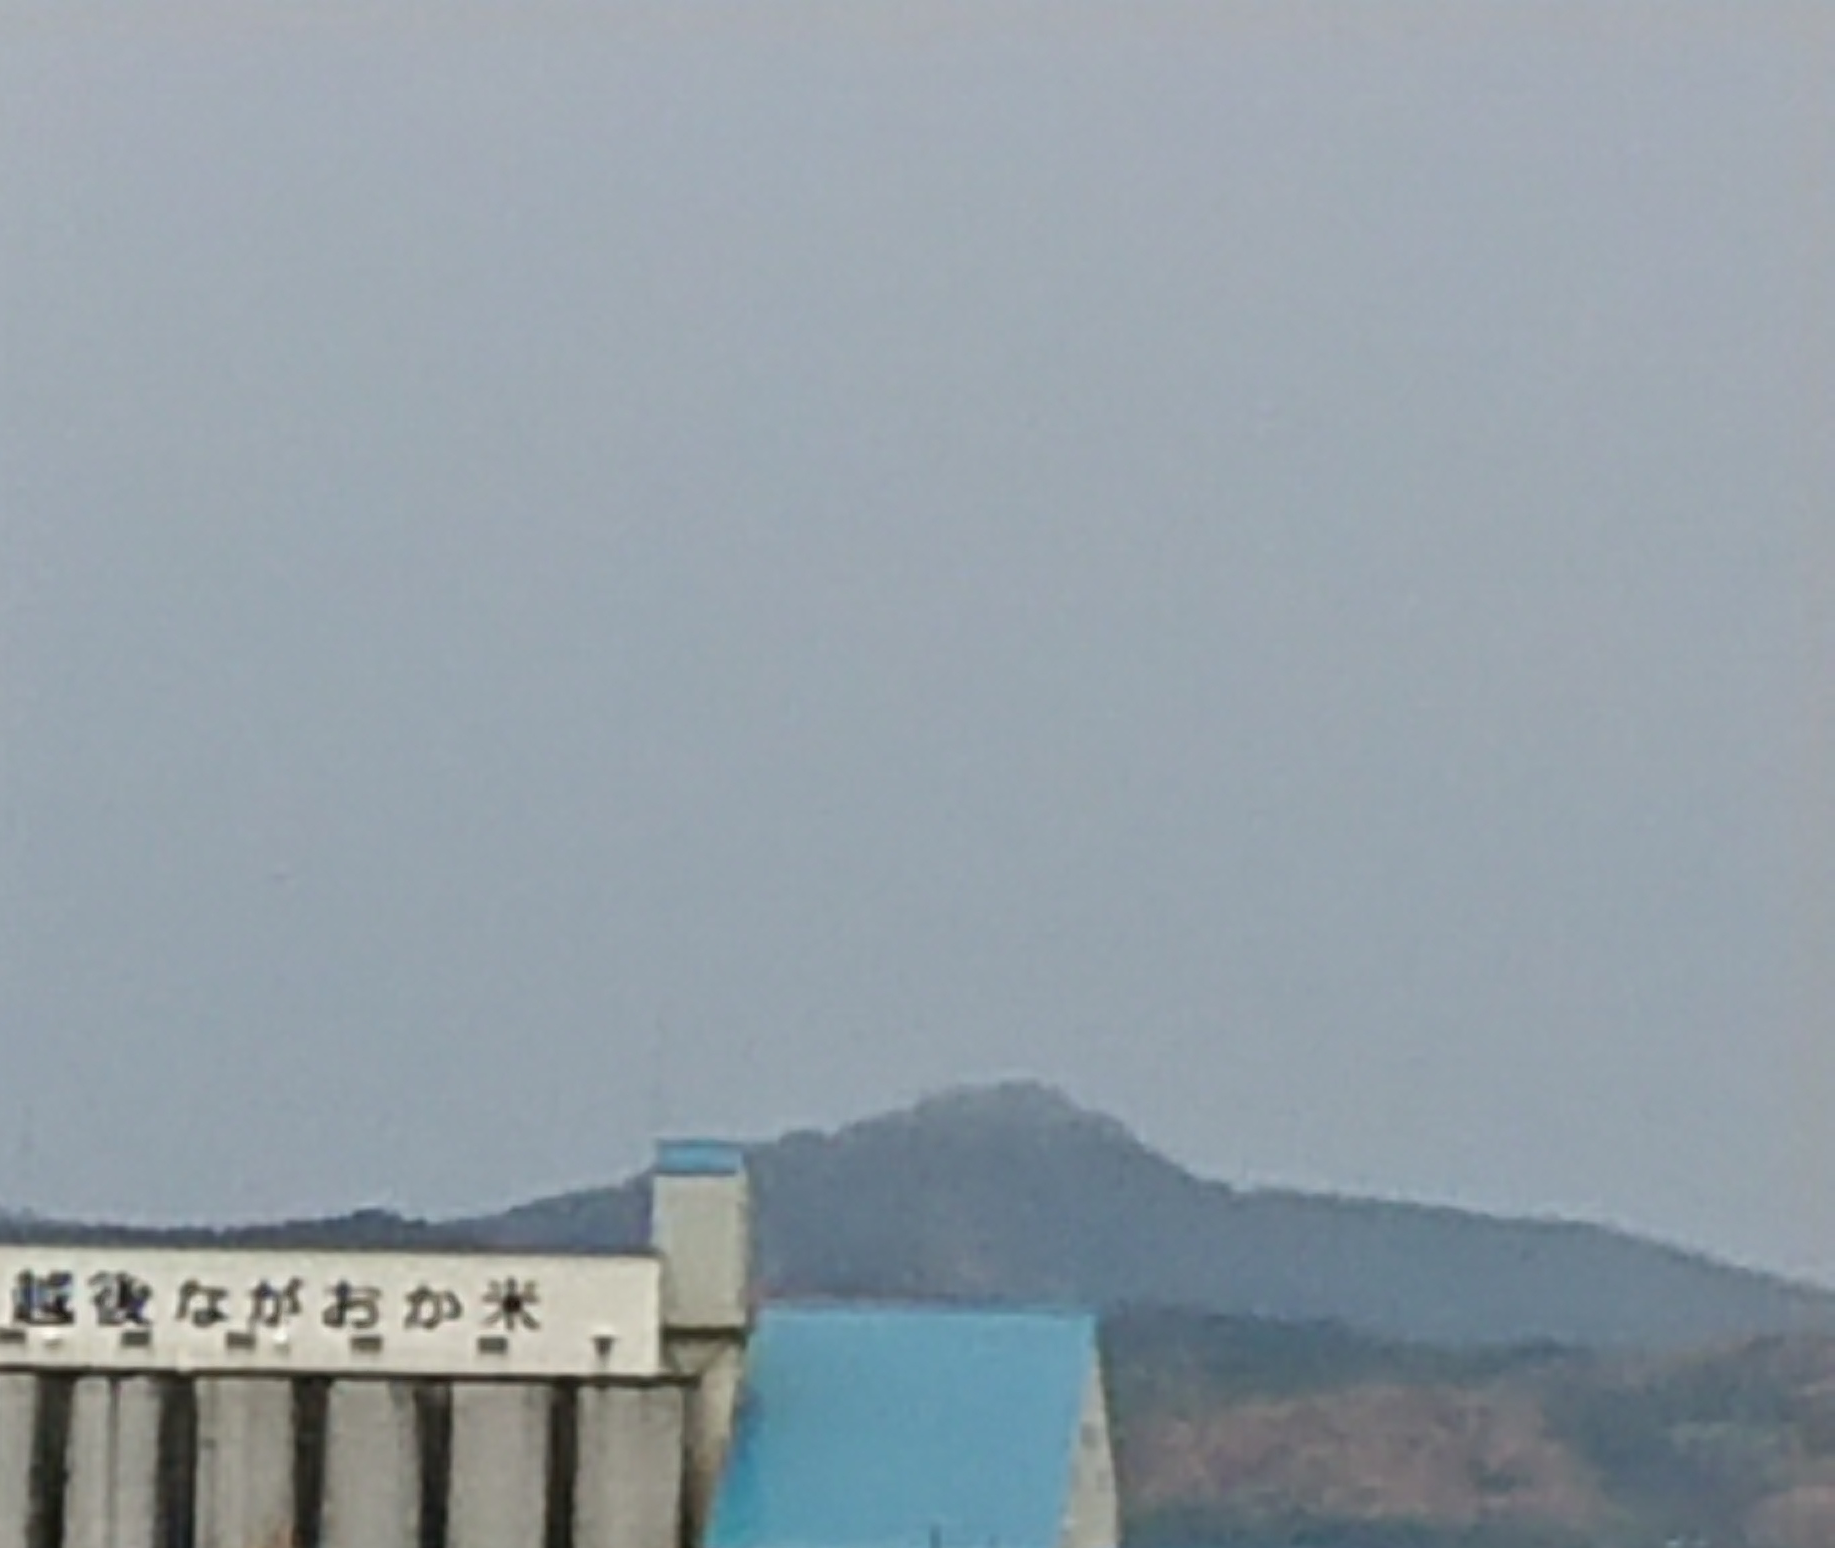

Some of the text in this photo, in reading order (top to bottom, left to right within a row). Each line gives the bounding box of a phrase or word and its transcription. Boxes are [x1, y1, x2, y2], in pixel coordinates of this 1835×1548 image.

[9, 1270, 541, 1333] 越後ながおか米
